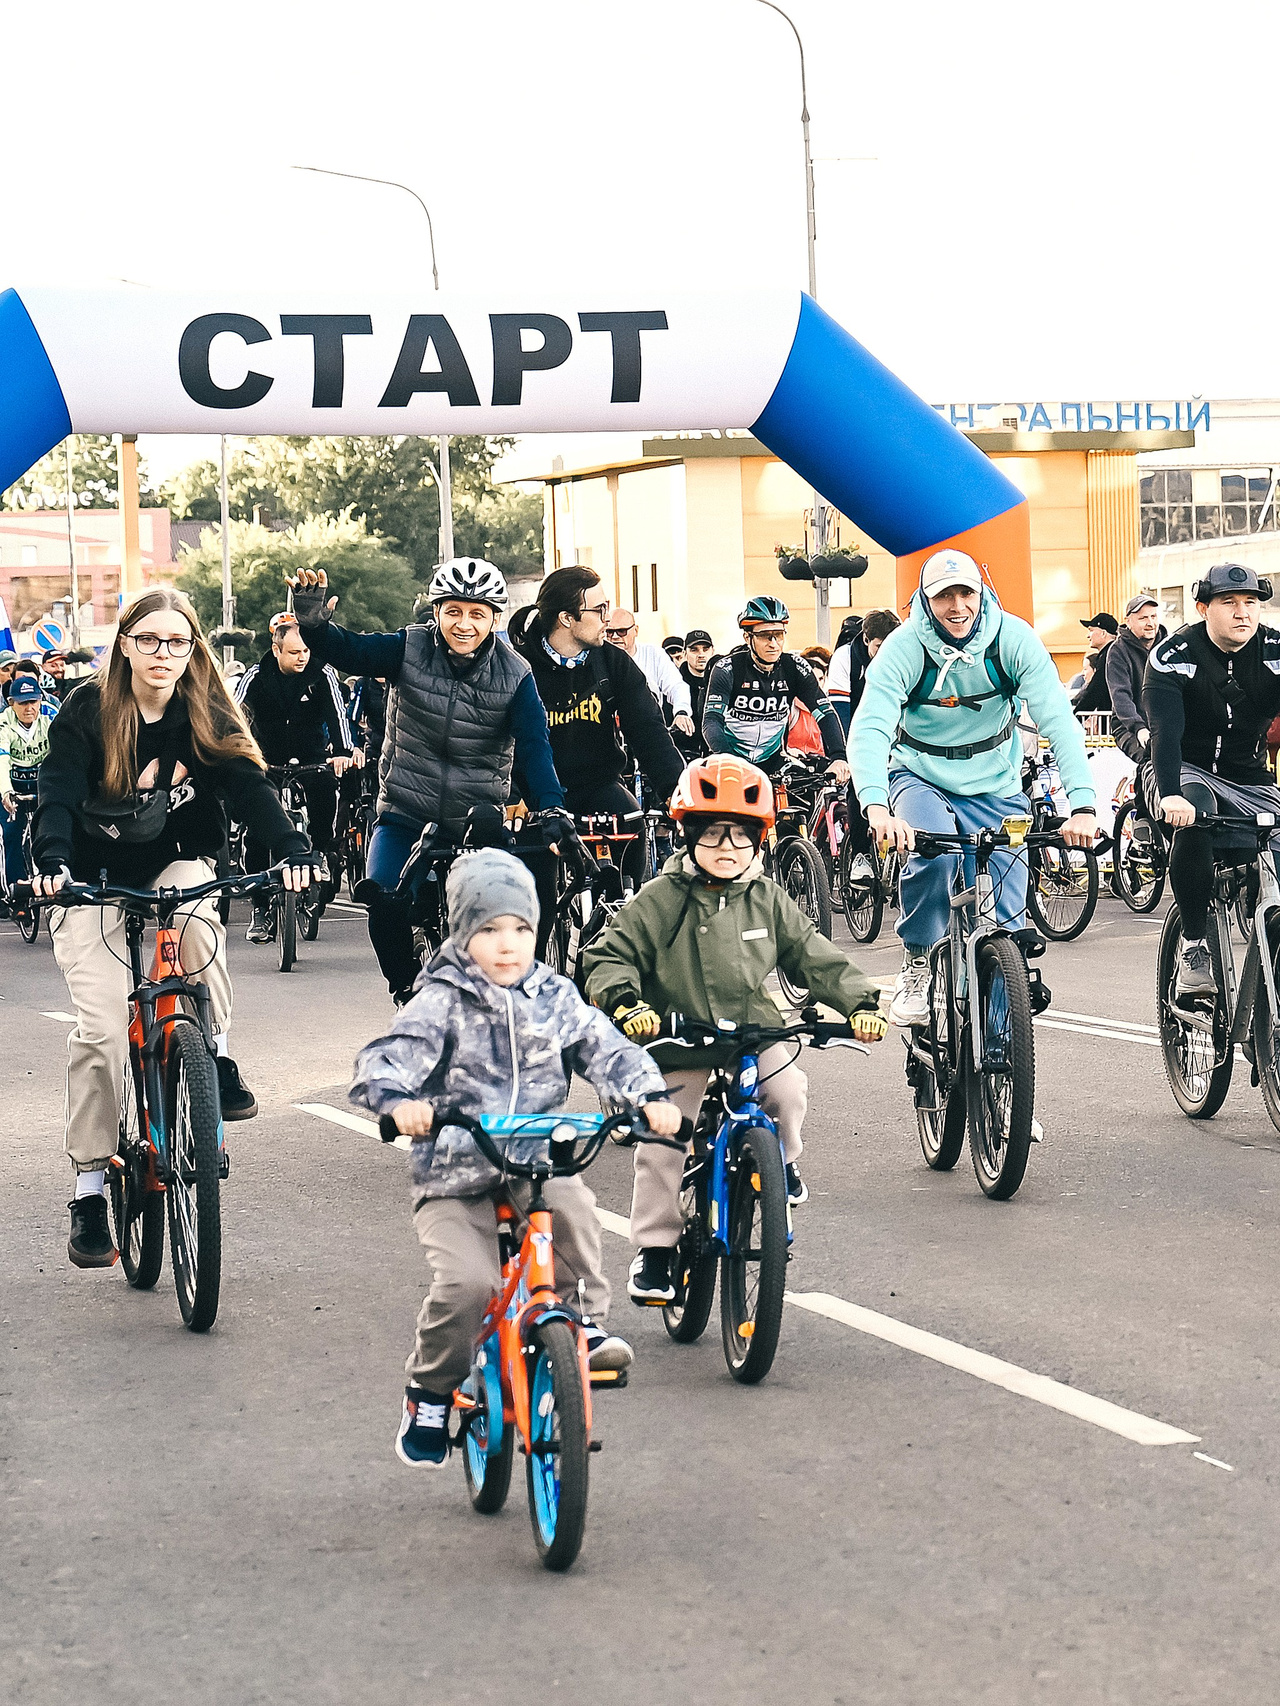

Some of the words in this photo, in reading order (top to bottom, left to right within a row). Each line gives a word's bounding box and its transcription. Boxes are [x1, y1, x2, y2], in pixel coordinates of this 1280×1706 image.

[178, 310, 668, 409] СТАРТ
[931, 394, 1210, 431] НАЛЬНЫЙ
[734, 695, 789, 713] BORA
